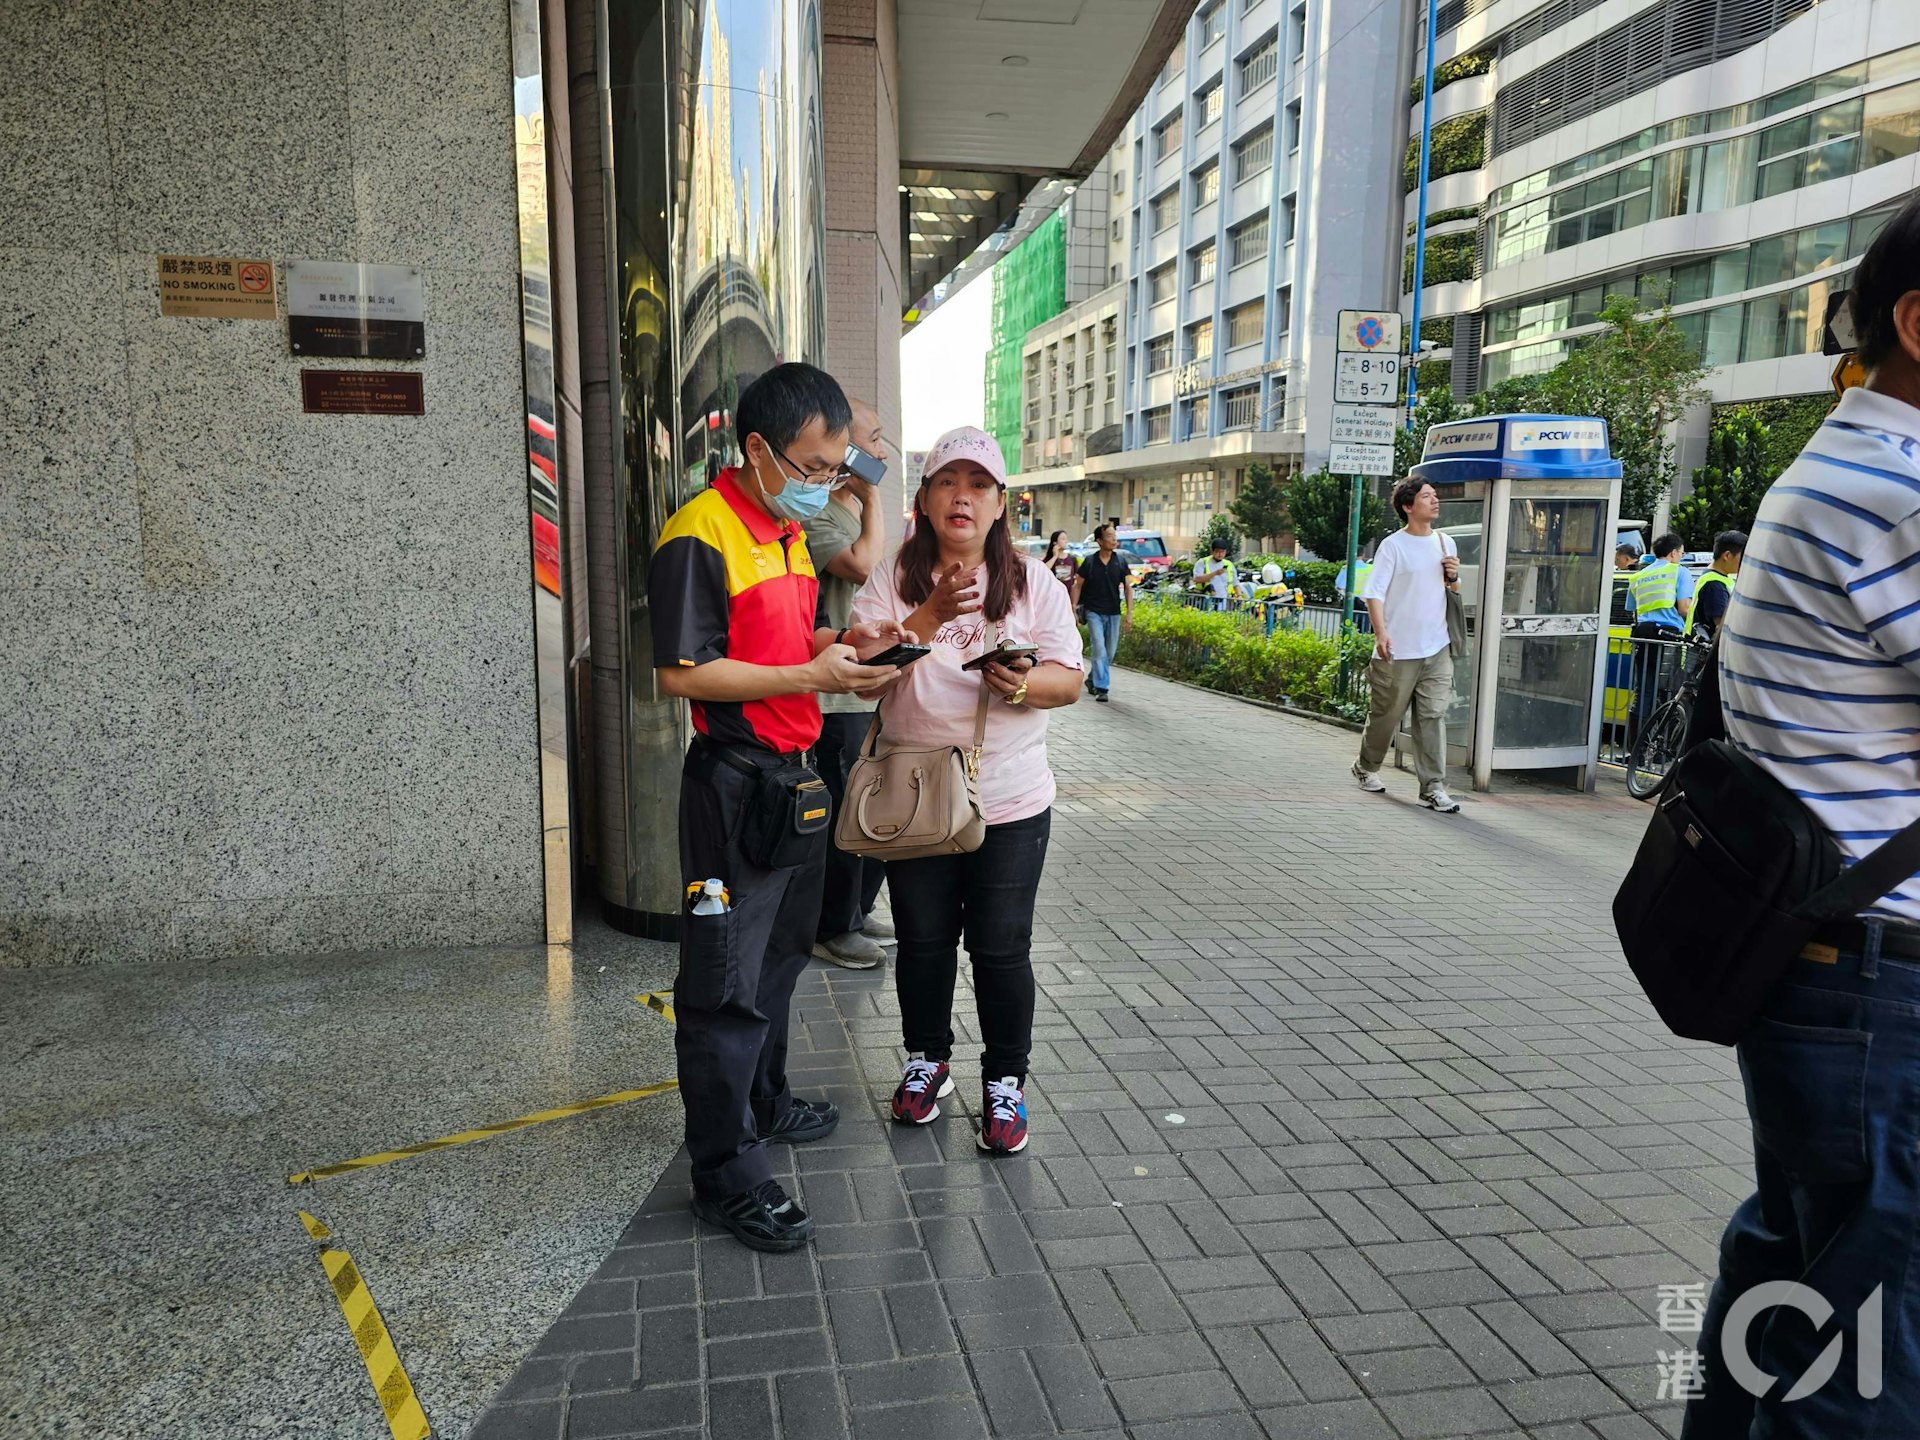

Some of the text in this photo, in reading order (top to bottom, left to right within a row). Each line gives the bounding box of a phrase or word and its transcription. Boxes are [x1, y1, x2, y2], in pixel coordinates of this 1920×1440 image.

[162, 259, 233, 276] 嚴禁吸煙
[163, 280, 236, 291] NO SMOKING
[1341, 364, 1358, 374] 上午
[1353, 410, 1377, 418] Except
[1335, 417, 1393, 427] General Holidays
[1335, 428, 1391, 438] 公眾假期例外
[1538, 431, 1571, 441] PCCW
[1440, 434, 1464, 445] PCCW
[1345, 446, 1367, 454] Except
